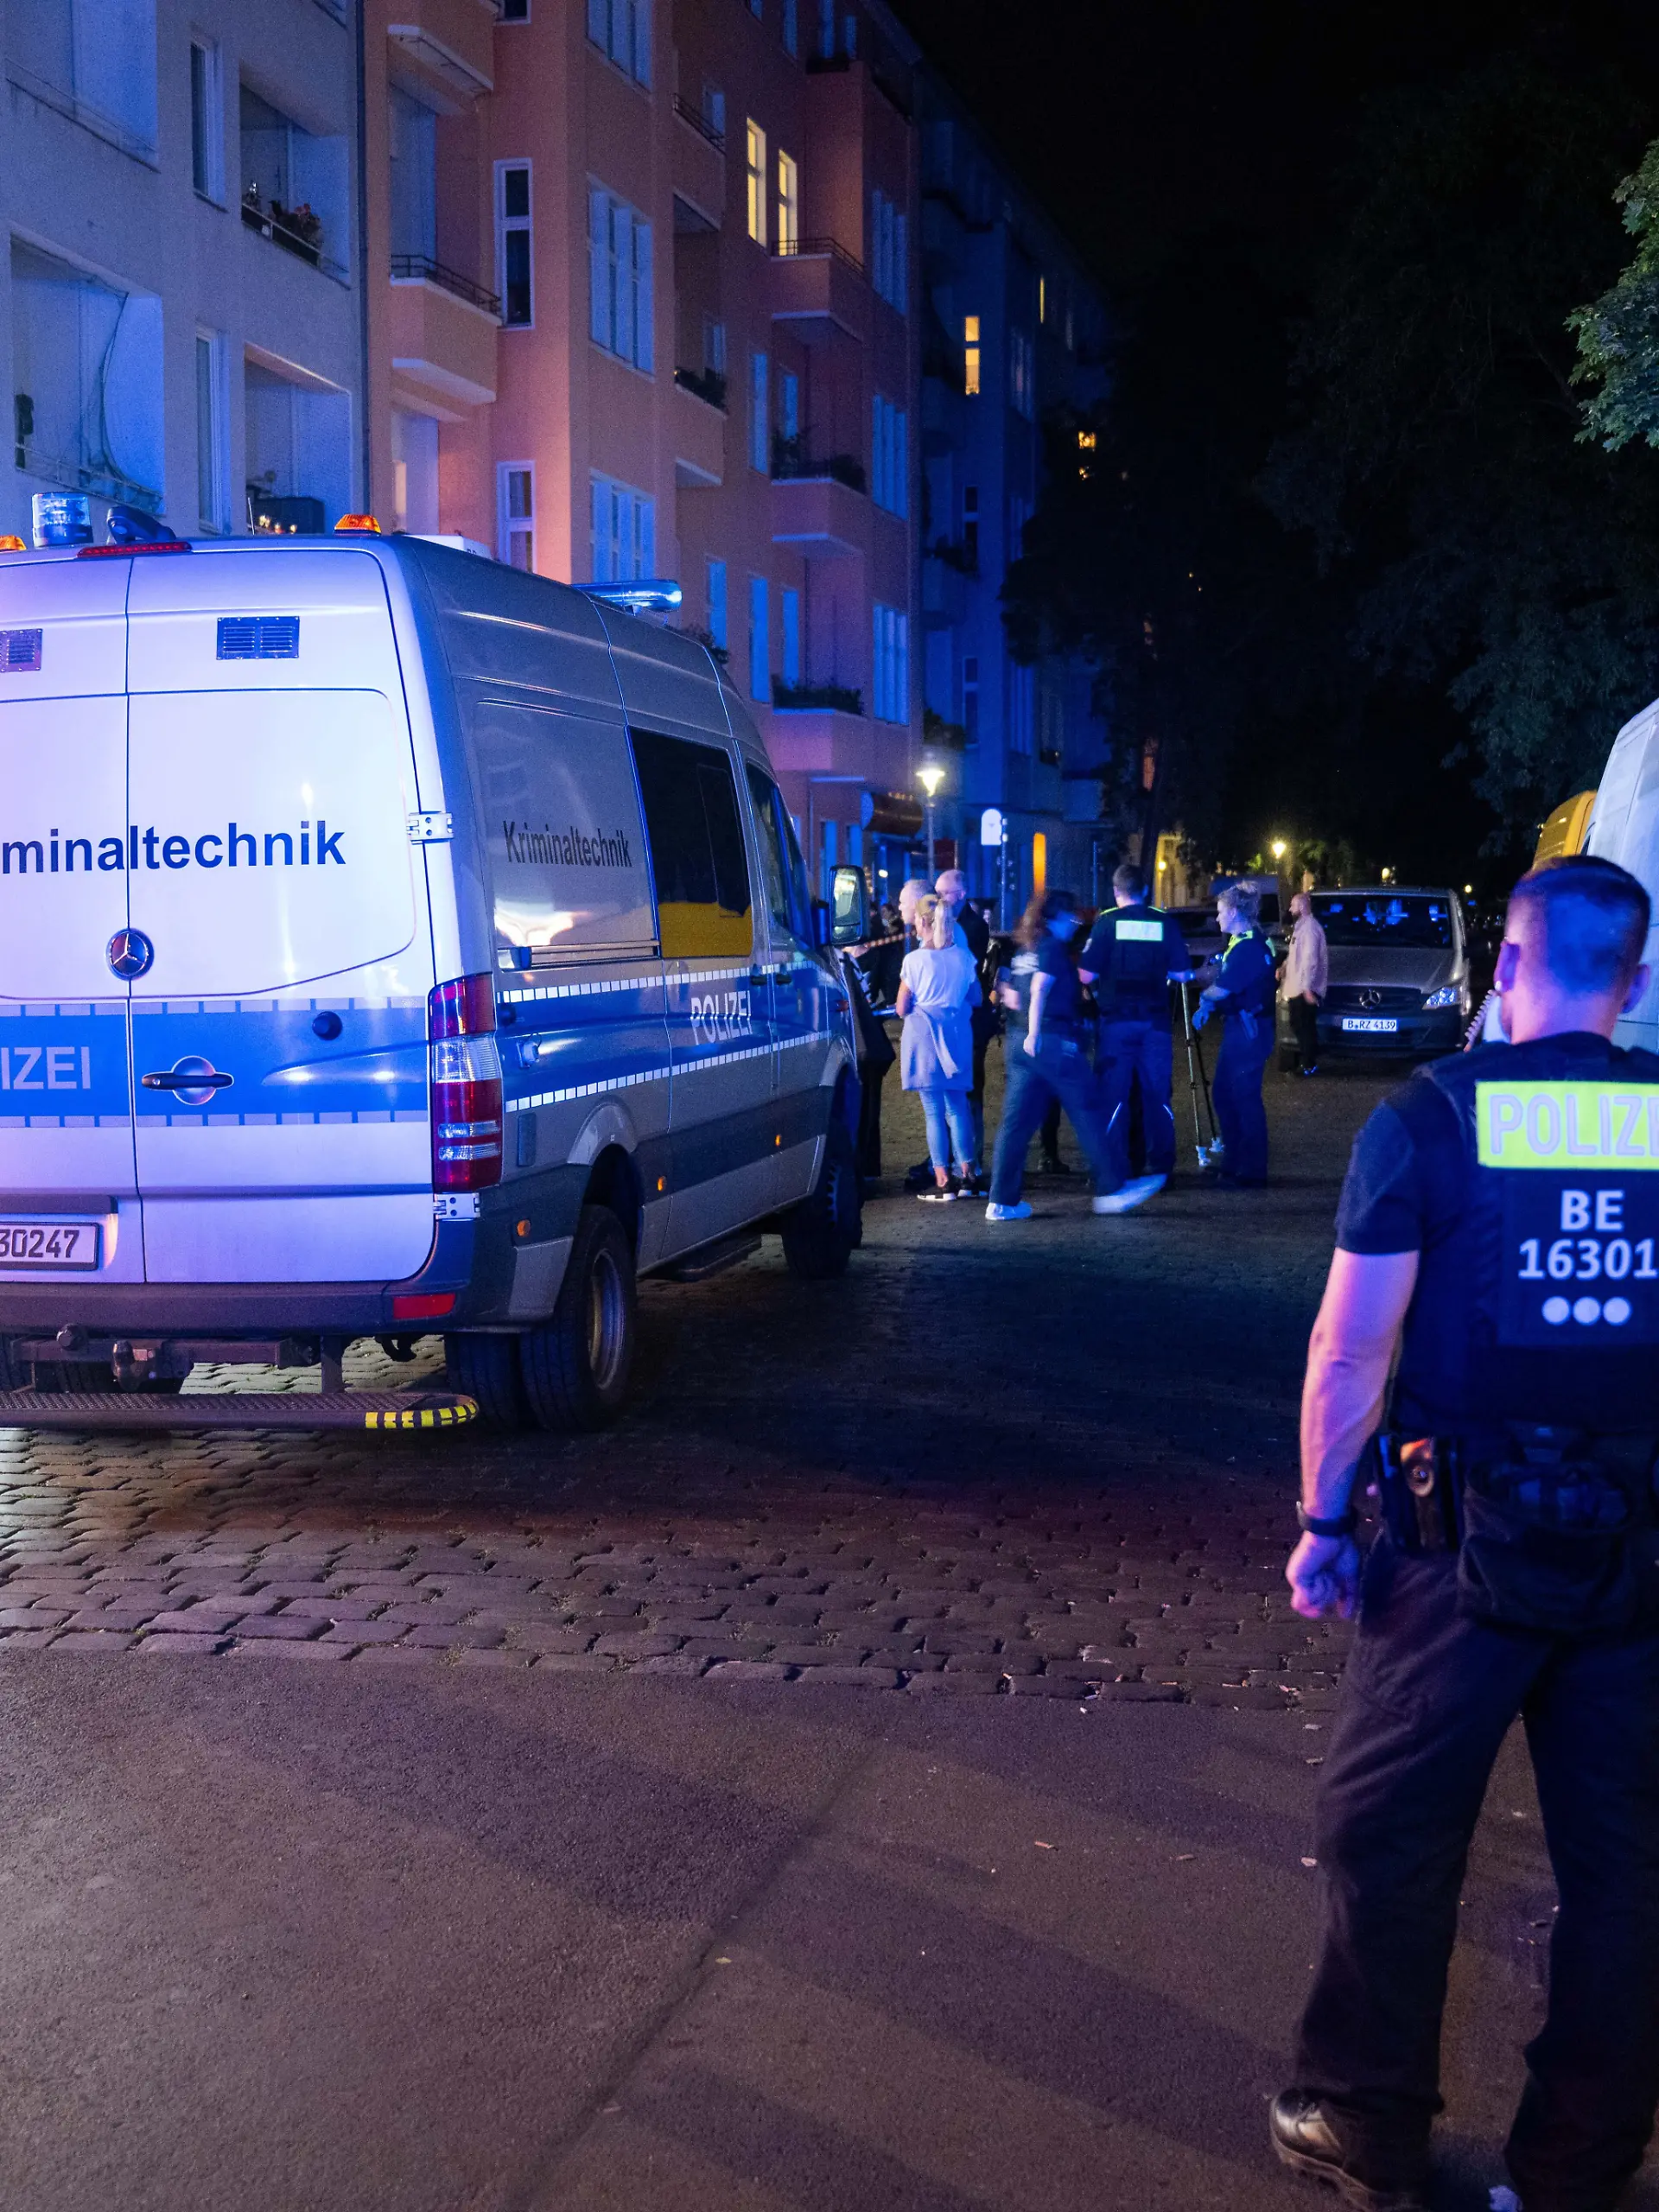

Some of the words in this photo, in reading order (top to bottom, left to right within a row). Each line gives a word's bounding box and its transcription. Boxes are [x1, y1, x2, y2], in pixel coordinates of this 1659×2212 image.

[2, 820, 346, 874] minaltechnik
[503, 820, 632, 868] Kriminaltechnik
[690, 990, 753, 1046] POLIZEI
[1348, 1020, 1354, 1029] B
[1373, 1020, 1395, 1030] 4139
[1, 1046, 91, 1090] IZEI
[1560, 1189, 1625, 1231] BE
[0, 1229, 79, 1258] 30247
[1518, 1237, 1659, 1280] 16301
